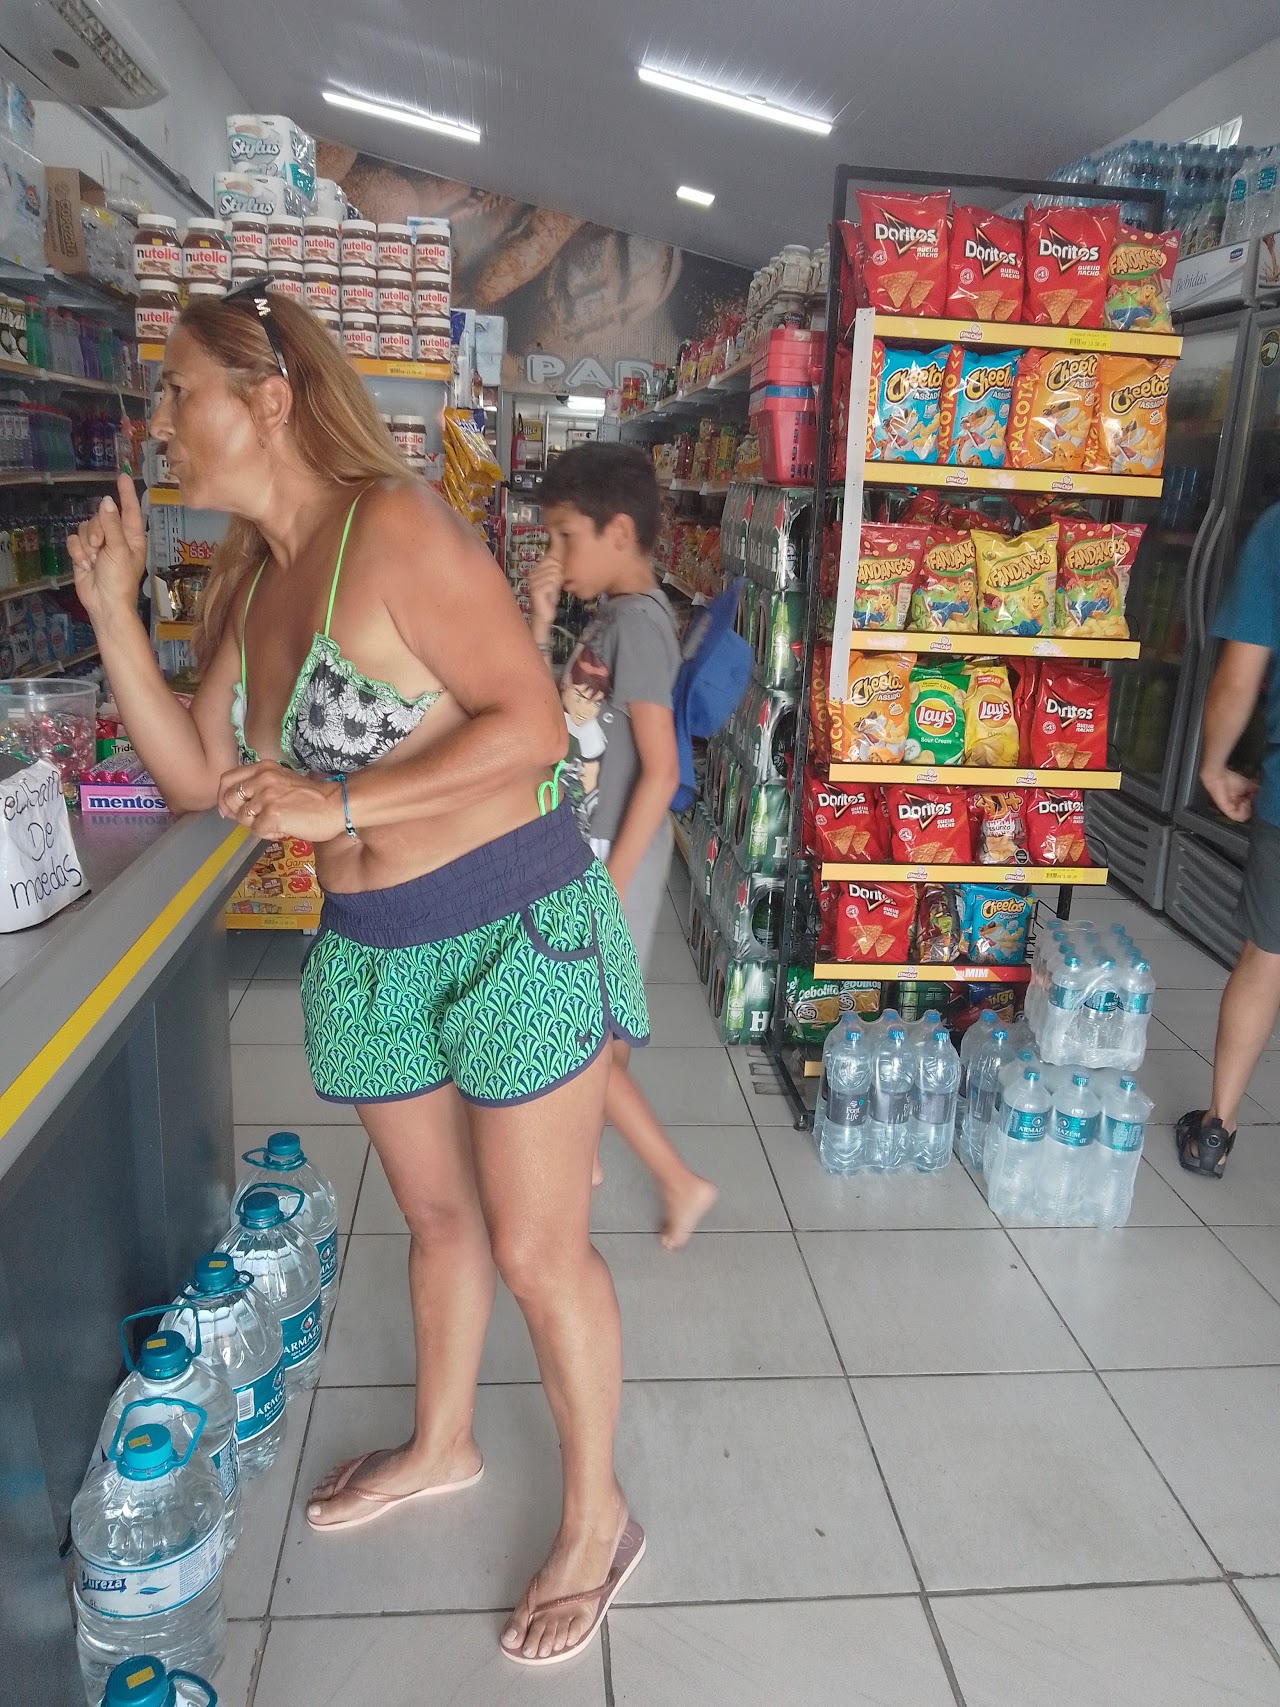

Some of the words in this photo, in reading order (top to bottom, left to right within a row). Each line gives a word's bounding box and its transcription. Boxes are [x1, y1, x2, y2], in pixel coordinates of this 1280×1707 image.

[230, 138, 280, 159] Stylus
[875, 223, 937, 243] Doritos
[268, 236, 298, 247] nutella
[304, 239, 335, 249] nutella
[342, 241, 372, 251] nutella
[378, 244, 408, 255] nutella
[1039, 238, 1099, 261] Doritos
[137, 249, 180, 261] nutella
[185, 252, 228, 264] nutella
[965, 240, 1017, 265] Doritos
[271, 282, 302, 293] nutella
[1175, 271, 1208, 293] Bebidas
[306, 285, 337, 296] nutella
[343, 287, 373, 298] nutella
[379, 290, 409, 301] nutella
[418, 292, 447, 303] nutella
[380, 335, 410, 346] nutella
[420, 337, 449, 348] nutella
[1111, 374, 1169, 414] Cheetos
[394, 434, 424, 444] nutella
[1066, 540, 1128, 569] FANDANGOS
[858, 558, 914, 584] ANDANGOS
[990, 549, 1051, 587] FANDANGOS
[979, 701, 1010, 720] Lay's
[1046, 698, 1093, 719] Doritos
[918, 706, 953, 728] Lay's
[88, 796, 167, 809] mentos
[818, 793, 865, 806] Doritos
[898, 803, 952, 819] Doritos
[28, 822, 54, 861] De
[10, 854, 82, 909] moedas
[982, 899, 1025, 919] Cheetos
[82, 1571, 123, 1589] Pureza
